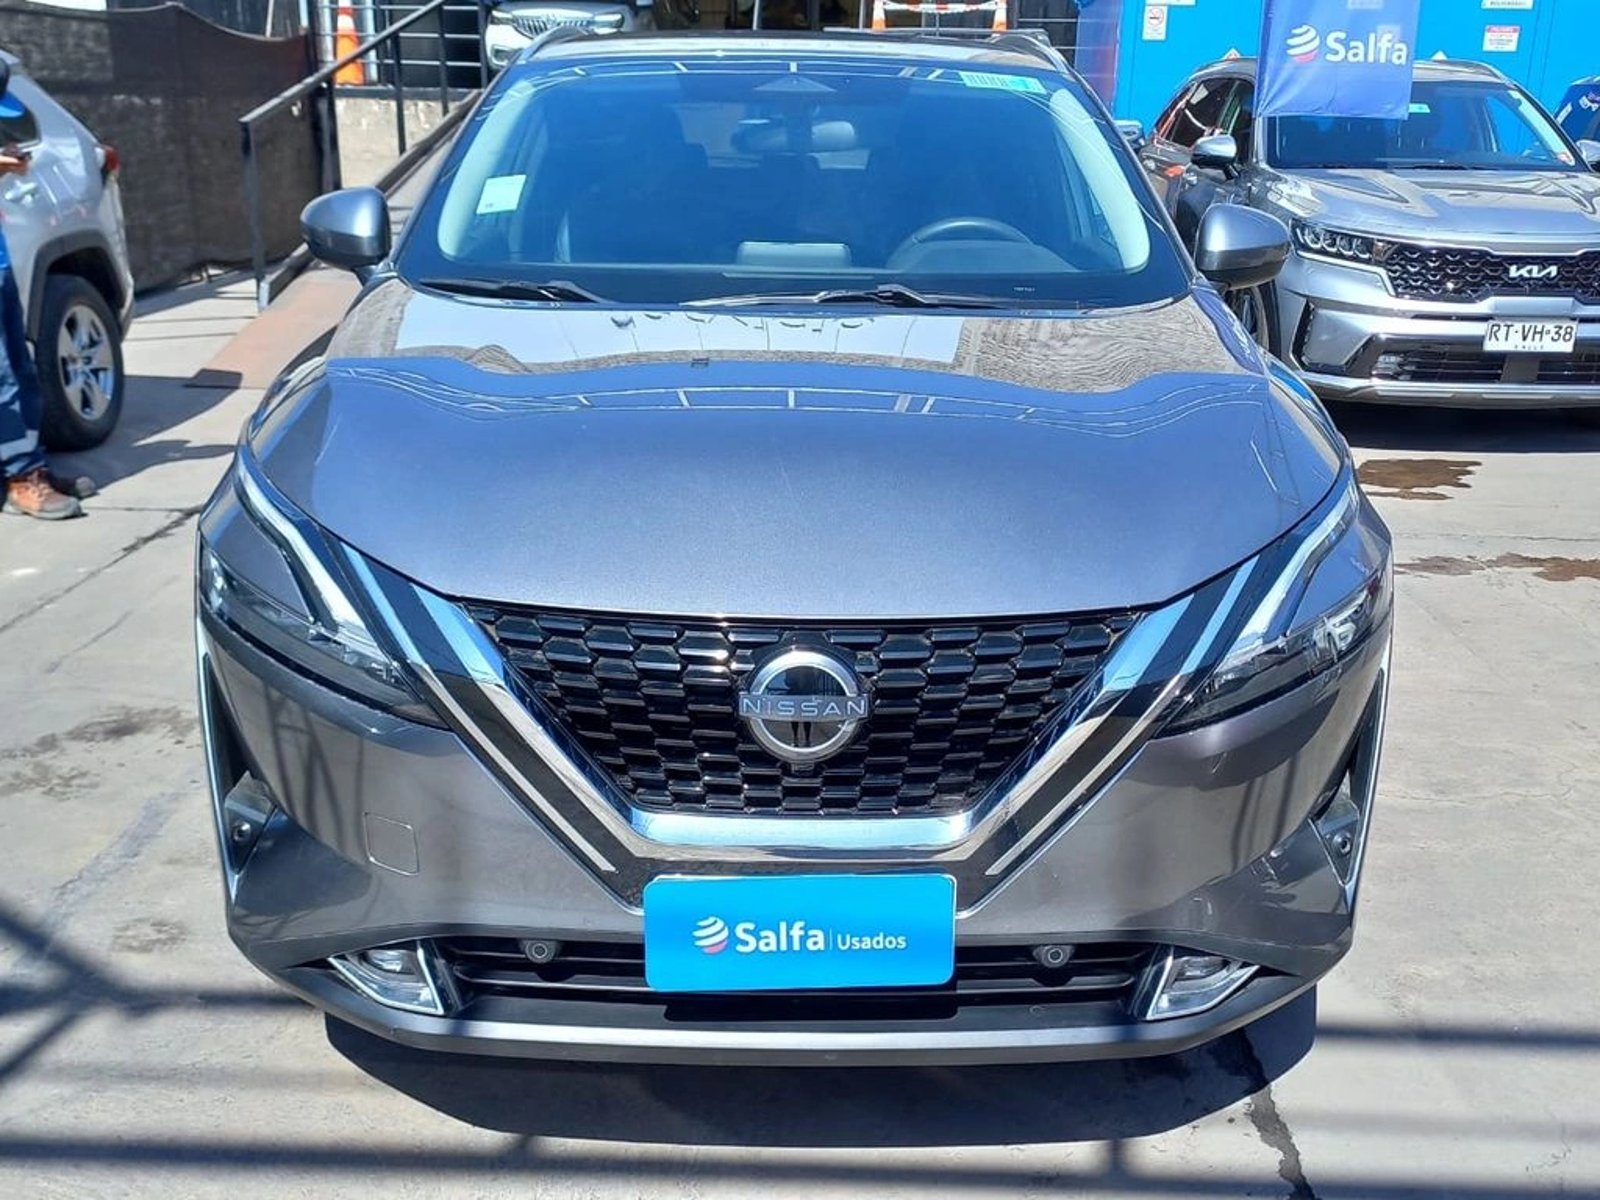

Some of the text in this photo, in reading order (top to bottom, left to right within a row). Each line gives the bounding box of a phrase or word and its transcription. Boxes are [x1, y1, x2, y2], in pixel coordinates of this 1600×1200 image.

[1325, 30, 1407, 65] Salfa
[1509, 264, 1558, 278] KIA
[743, 698, 865, 716] NISSAN
[734, 920, 907, 953] Salfa Usados
